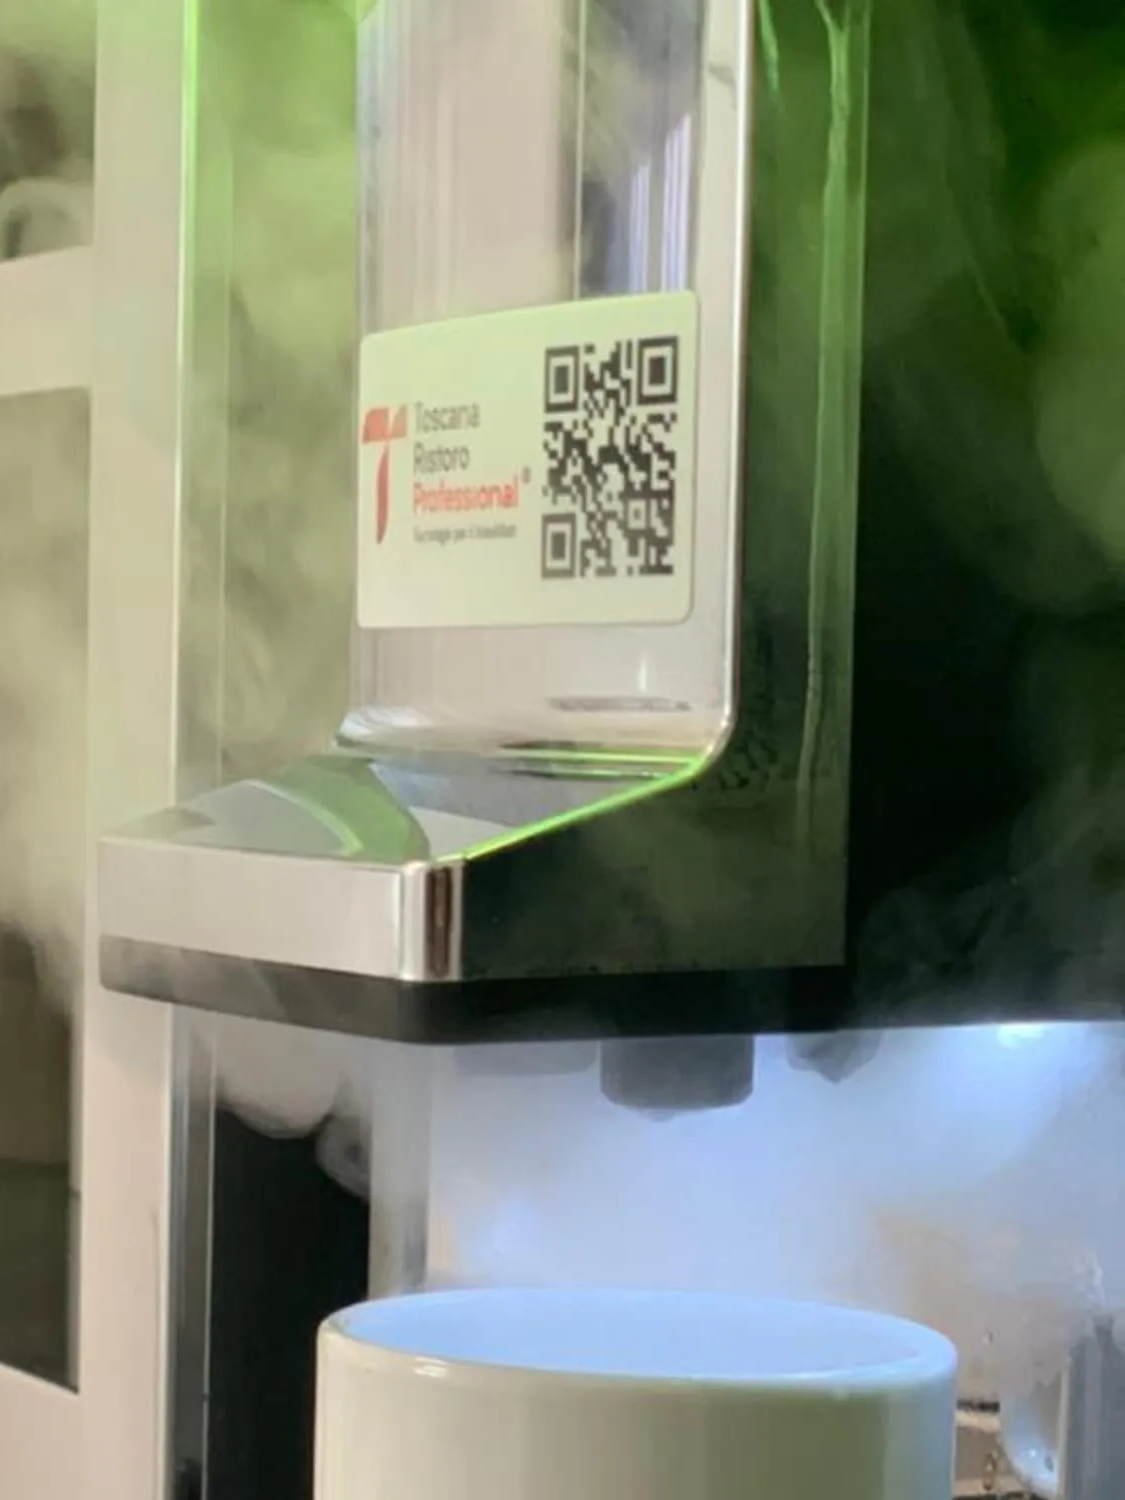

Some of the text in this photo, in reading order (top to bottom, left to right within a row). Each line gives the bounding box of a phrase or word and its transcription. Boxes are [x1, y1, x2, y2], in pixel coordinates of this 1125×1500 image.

[414, 401, 480, 434] Toscana
[413, 441, 470, 475] Ristoro
[413, 473, 520, 518] Professional
